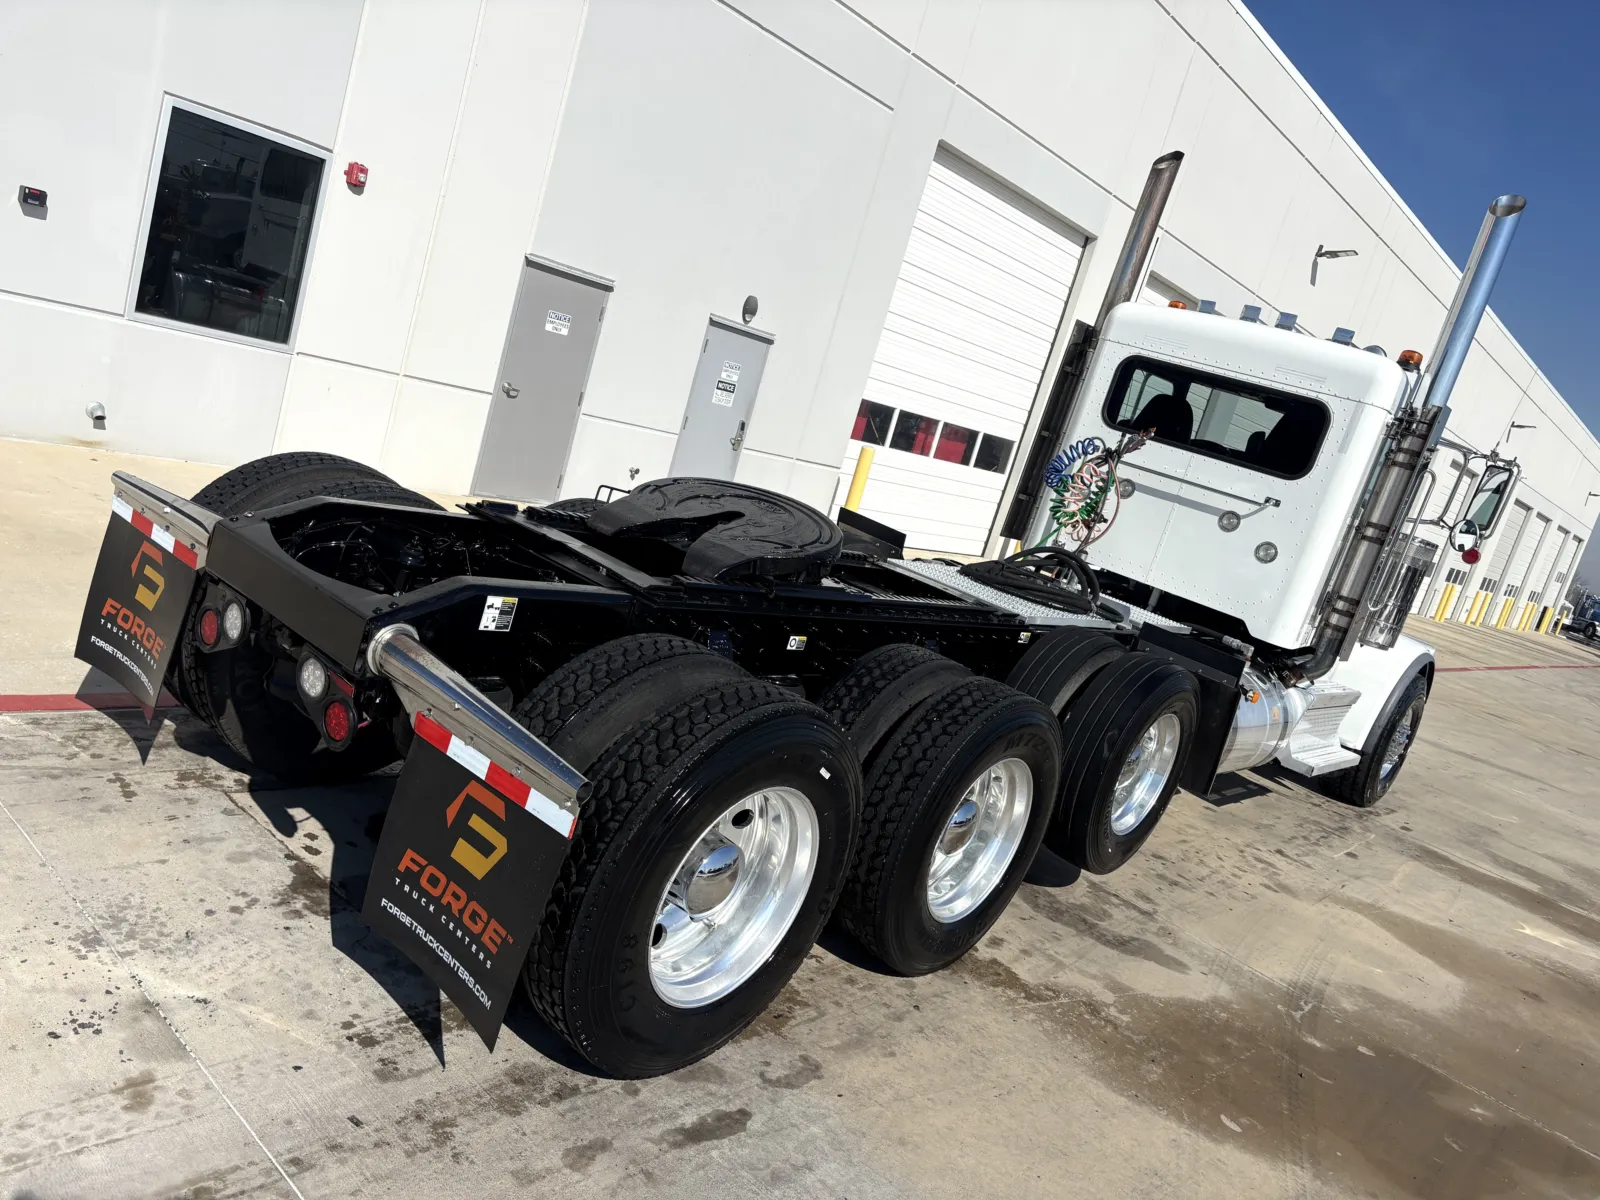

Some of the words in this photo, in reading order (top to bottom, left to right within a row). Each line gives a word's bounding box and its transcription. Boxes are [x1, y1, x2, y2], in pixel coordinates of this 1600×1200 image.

[550, 311, 570, 323] NOTICE
[717, 382, 735, 392] NOTICE
[100, 618, 128, 641] TRUCK
[101, 597, 164, 660] FORGE
[395, 877, 435, 914] TRUCK
[441, 914, 492, 969] CENTERS
[397, 848, 507, 955] FORGE
[380, 897, 492, 1011] FORGETRUCKCENTERS.COM
